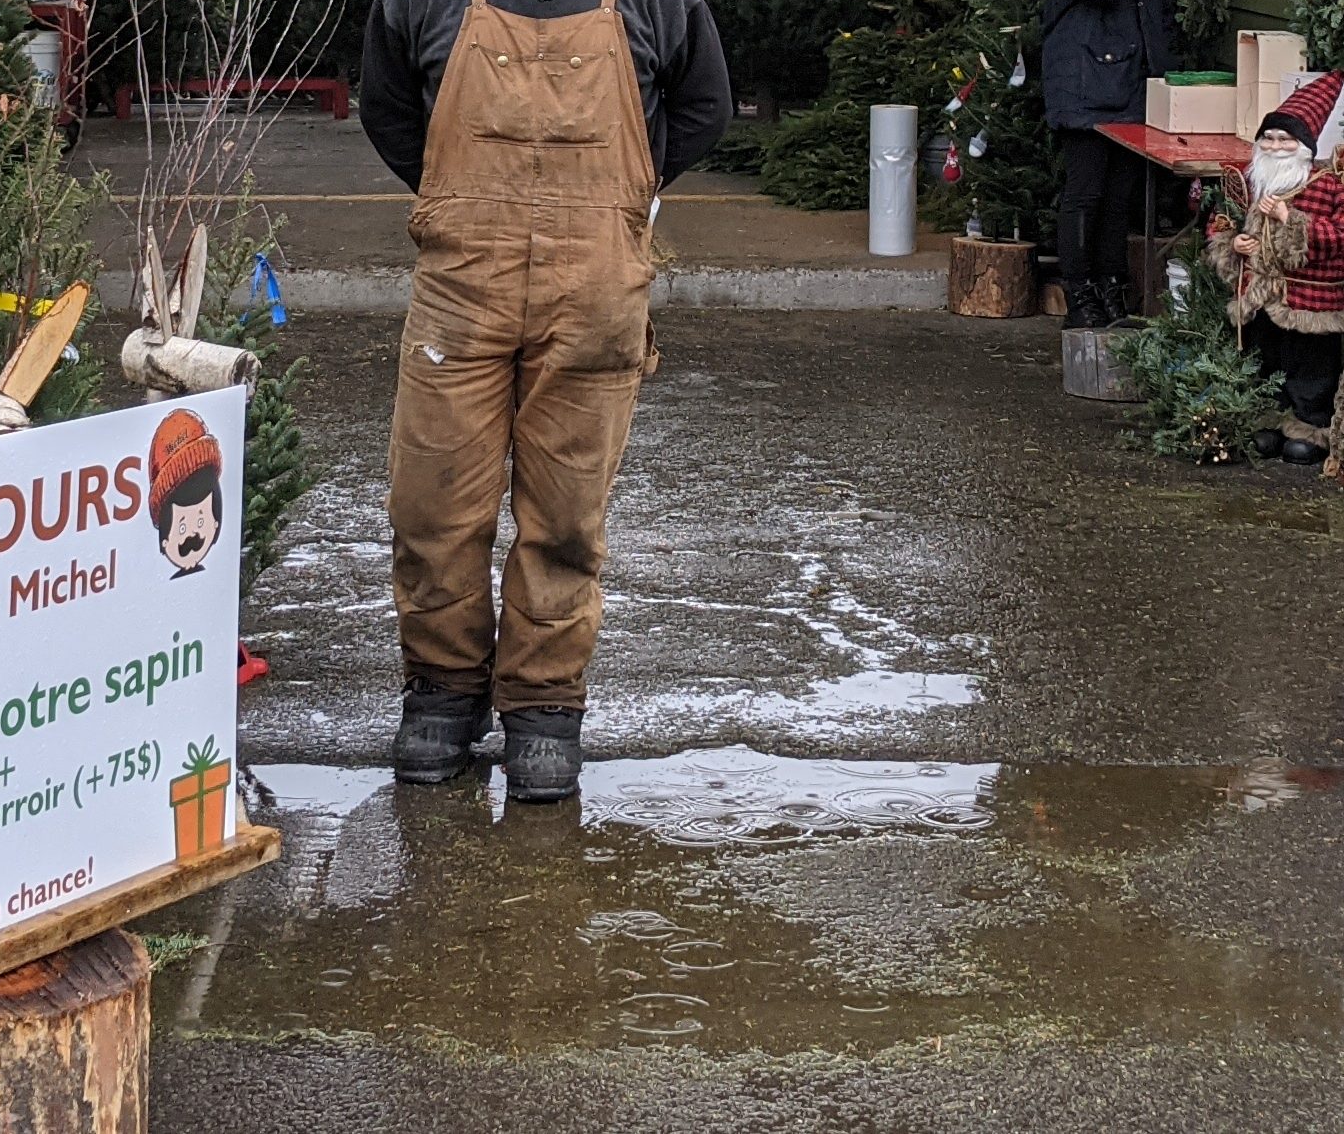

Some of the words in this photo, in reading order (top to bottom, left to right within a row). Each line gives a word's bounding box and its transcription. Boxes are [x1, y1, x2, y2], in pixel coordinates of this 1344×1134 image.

[9, 550, 117, 618] Michel
[105, 631, 204, 709] sapin
[73, 740, 162, 809] (+75$)
[7, 856, 95, 916] chance!
